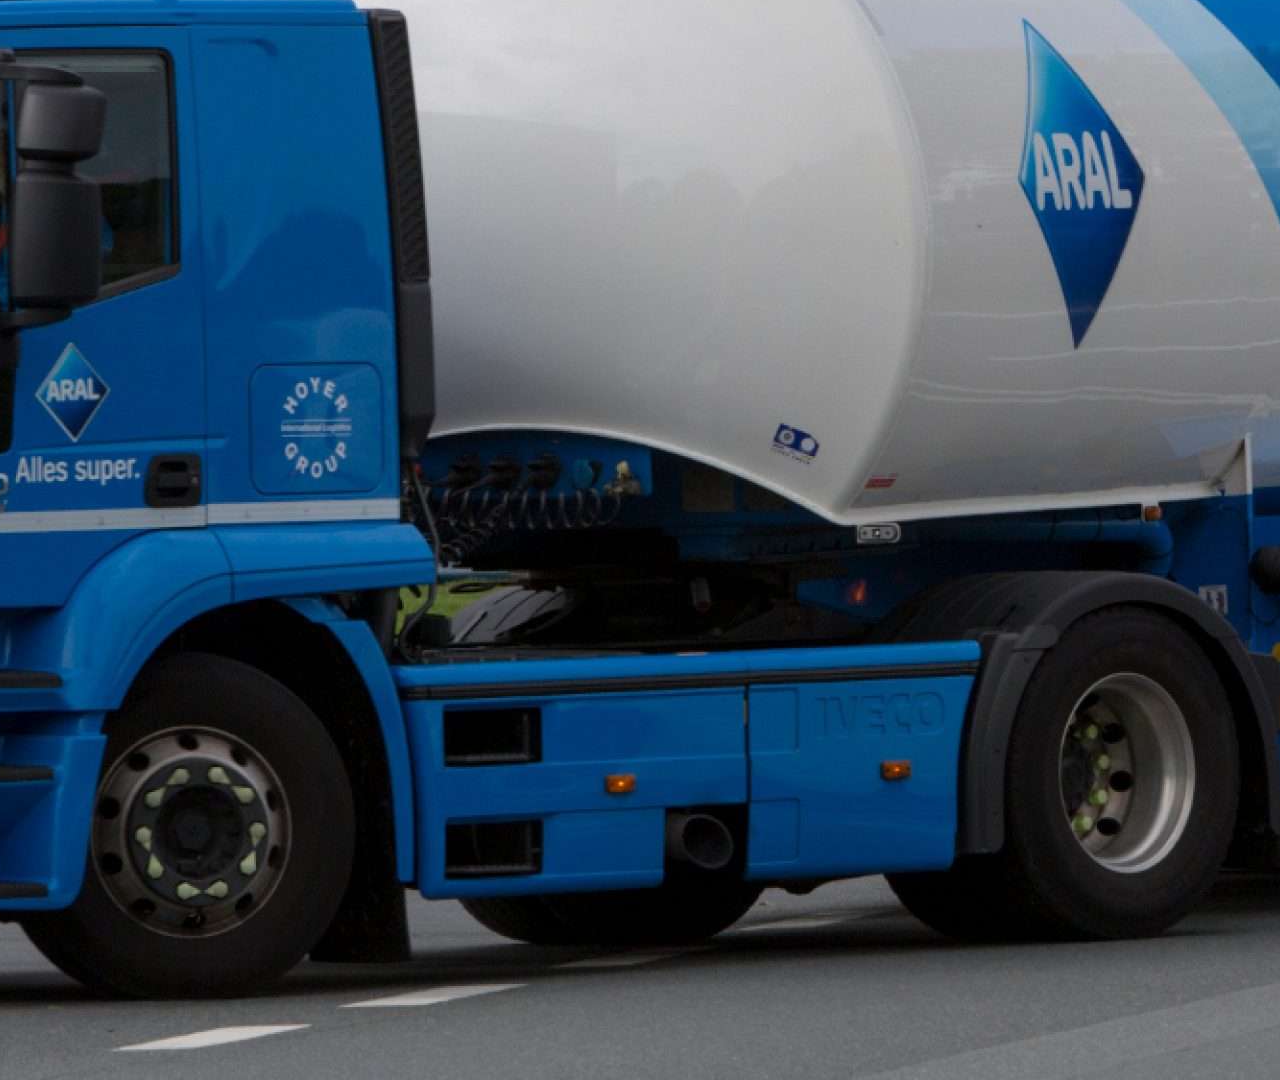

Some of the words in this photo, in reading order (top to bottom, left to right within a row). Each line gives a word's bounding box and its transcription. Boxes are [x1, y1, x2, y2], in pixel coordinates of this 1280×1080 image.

[1033, 130, 1132, 210] ARAL
[46, 377, 100, 402] ARAL
[283, 377, 348, 415] HOYER
[16, 456, 67, 483] Alles
[75, 458, 140, 486] super.
[285, 441, 347, 479] GROUP
[810, 691, 944, 736] IVECO
